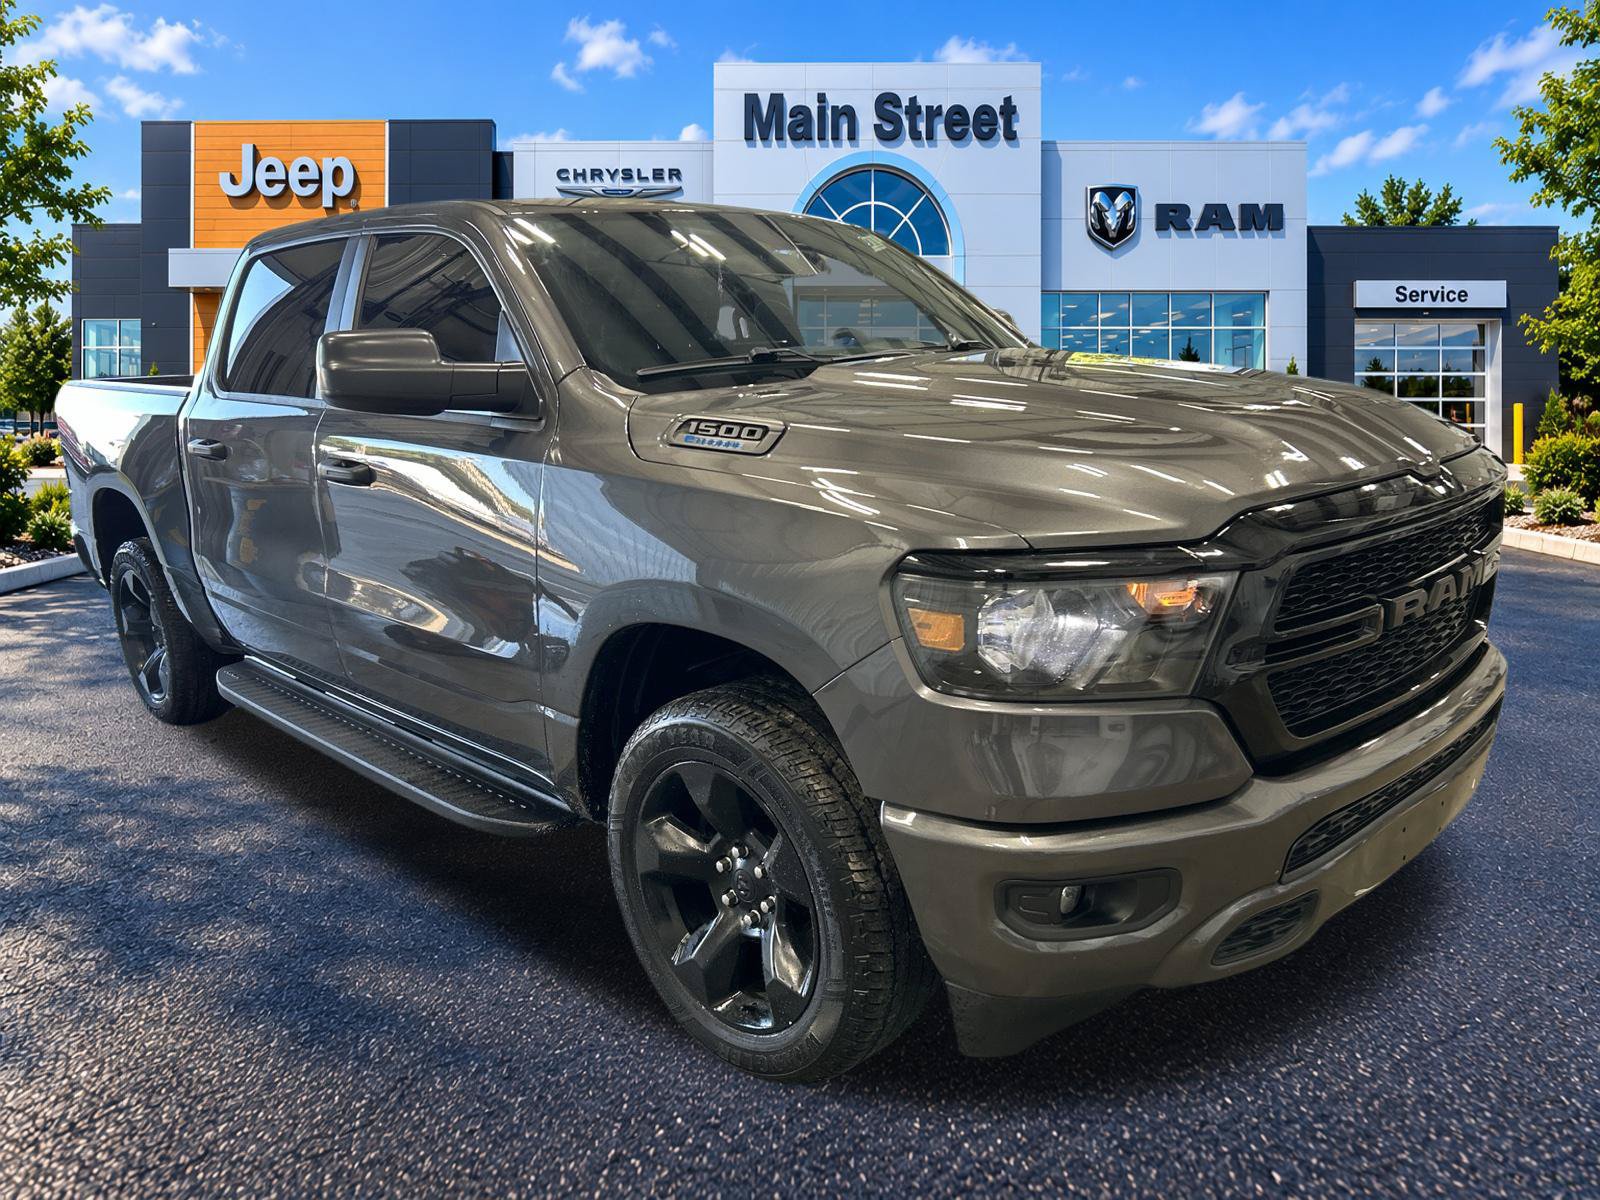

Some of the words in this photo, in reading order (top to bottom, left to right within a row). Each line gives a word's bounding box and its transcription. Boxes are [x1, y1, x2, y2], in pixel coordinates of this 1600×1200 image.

[744, 92, 858, 142] Main
[873, 91, 1019, 142] Street
[218, 143, 357, 209] Jeep
[556, 167, 683, 183] CHRYSLER
[1155, 203, 1284, 232] RAM
[1395, 285, 1469, 303] Service
[688, 421, 764, 440] 1500
[1390, 556, 1485, 627] RAM
